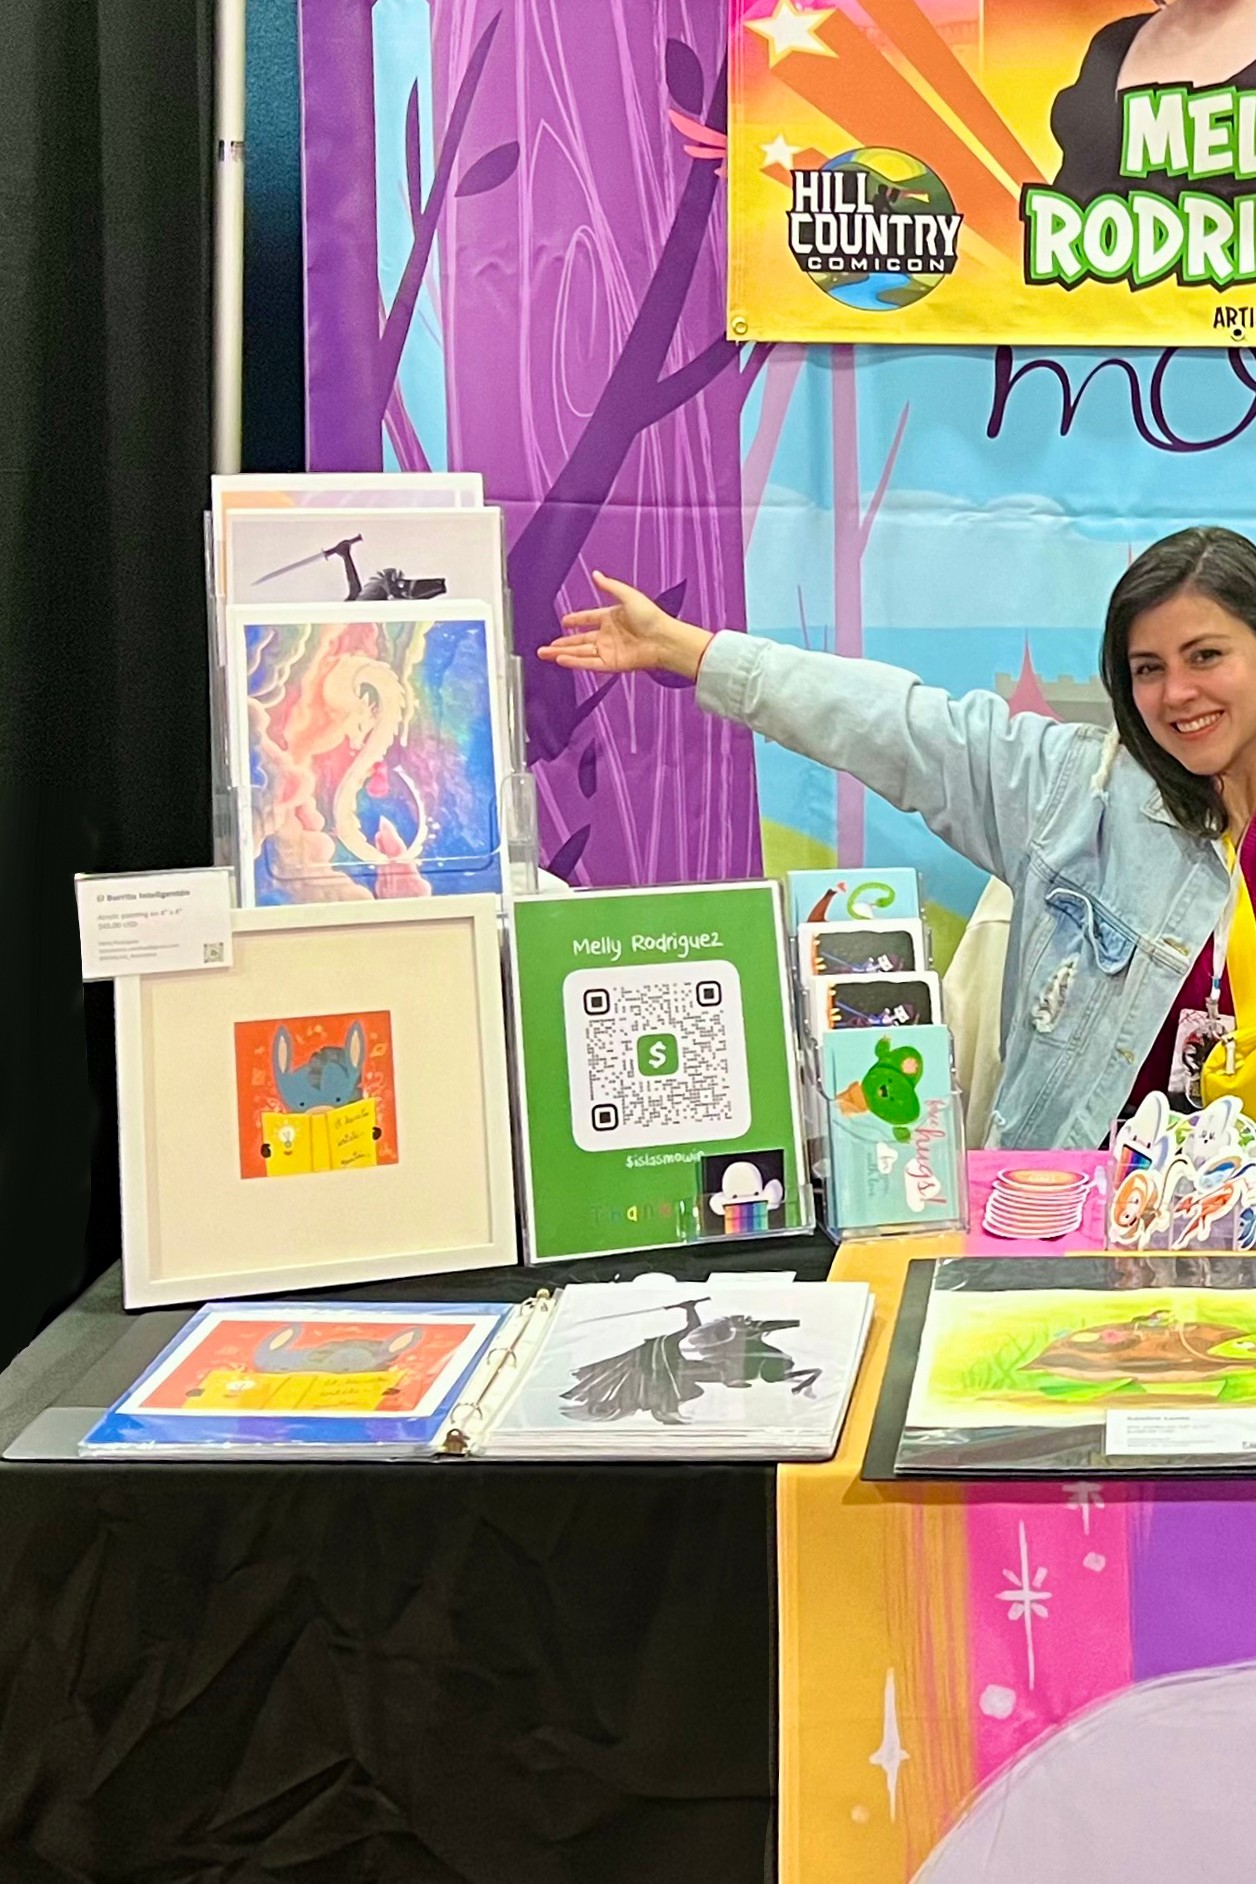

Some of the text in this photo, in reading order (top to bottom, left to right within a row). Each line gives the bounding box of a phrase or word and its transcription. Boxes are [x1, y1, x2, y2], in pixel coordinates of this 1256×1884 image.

[794, 171, 875, 213] HILL
[790, 213, 962, 256] COUNTRY
[808, 257, 945, 271] COMICON
[573, 932, 724, 961] Melly Rodriguez
[906, 1127, 947, 1204] hugs!
